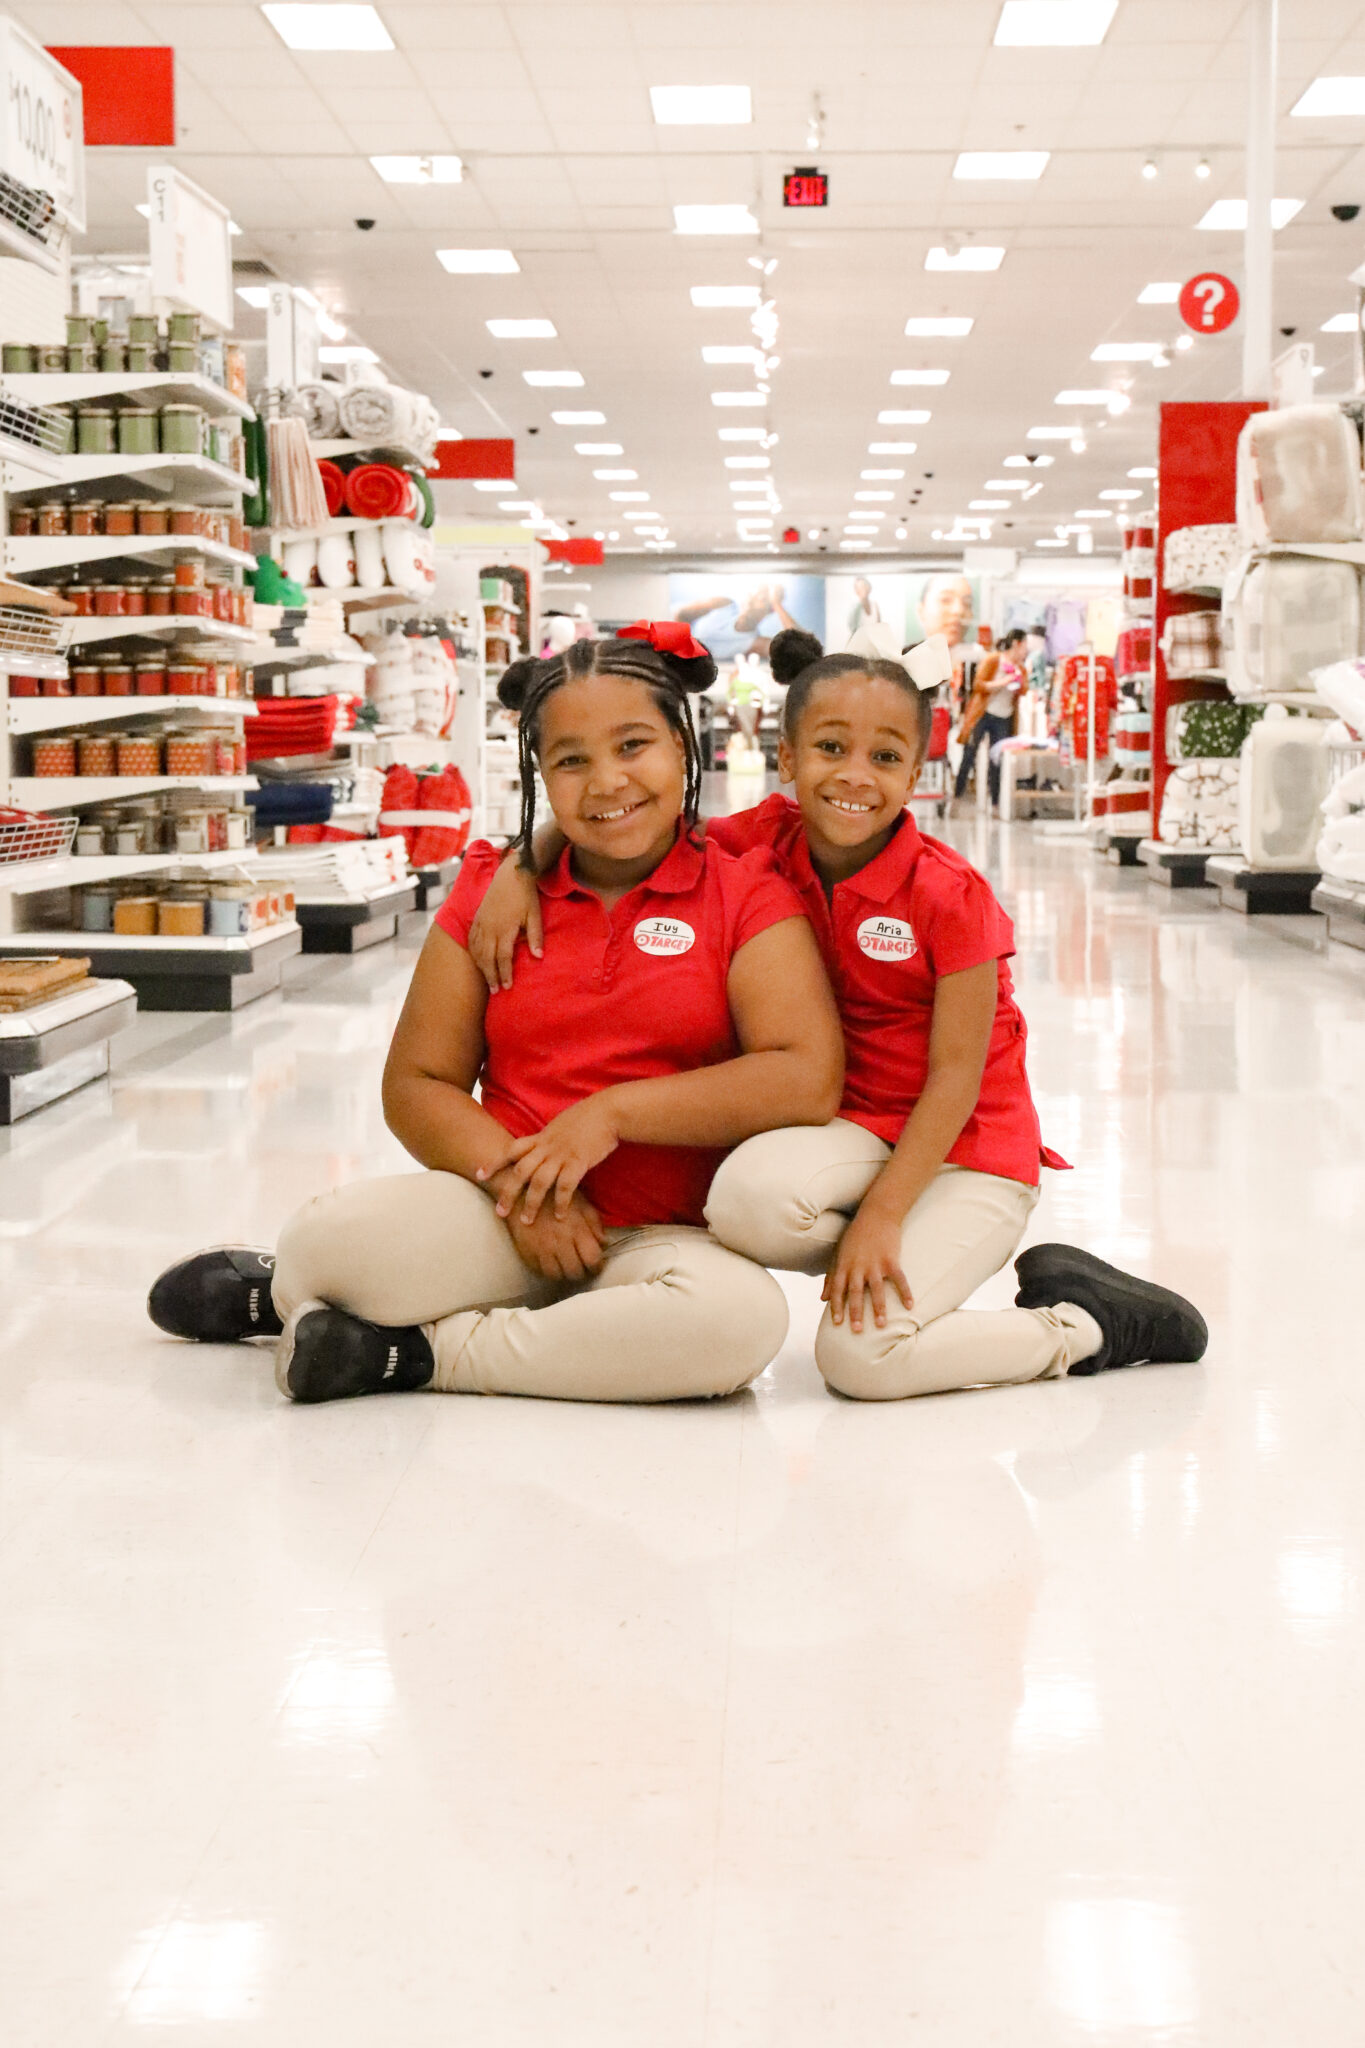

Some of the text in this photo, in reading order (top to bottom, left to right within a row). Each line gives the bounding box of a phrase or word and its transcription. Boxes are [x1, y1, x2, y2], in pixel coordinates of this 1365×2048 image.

[788, 175, 823, 206] EXIT
[876, 922, 902, 936] Aria
[649, 935, 692, 952] TARGET
[870, 937, 917, 955] TARGET
